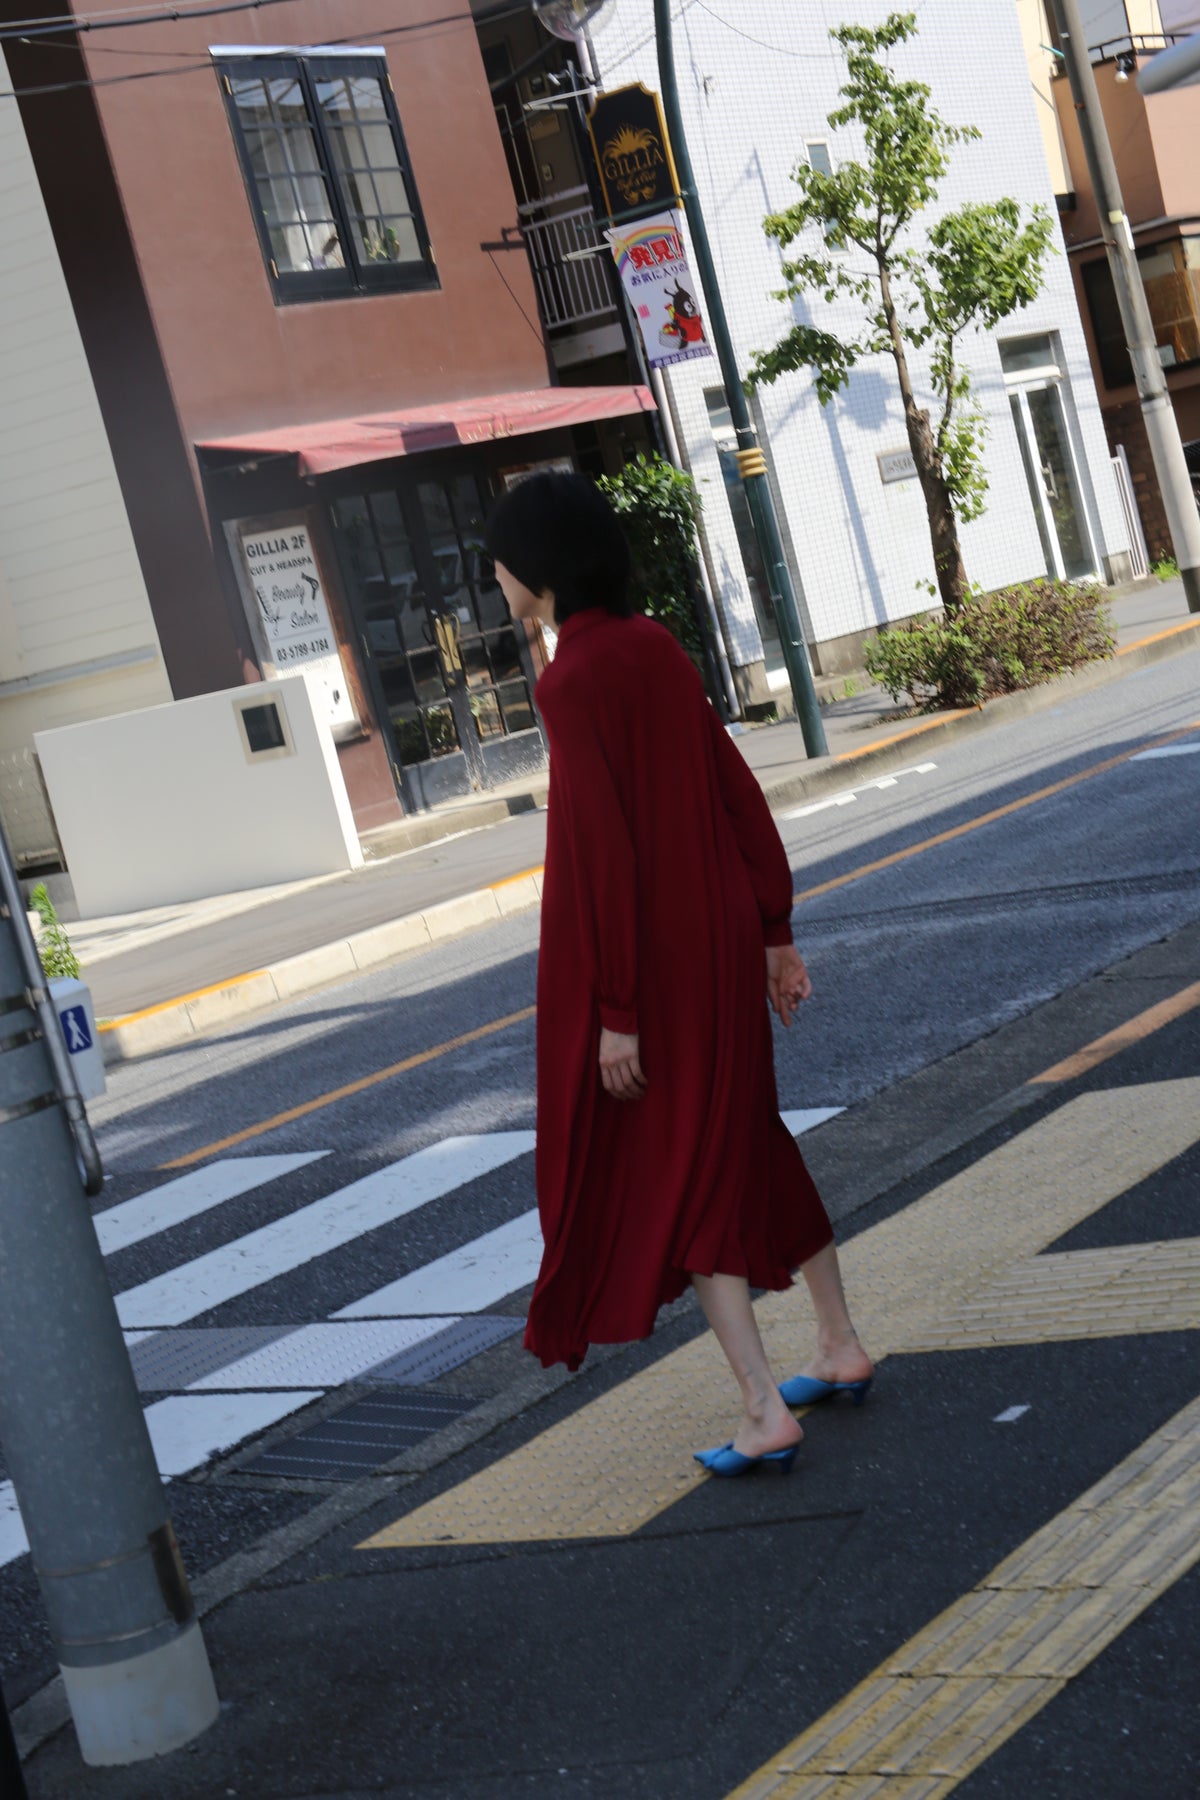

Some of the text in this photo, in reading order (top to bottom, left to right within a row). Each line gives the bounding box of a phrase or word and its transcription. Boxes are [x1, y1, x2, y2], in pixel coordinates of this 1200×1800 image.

[603, 147, 664, 180] GILLIA
[246, 534, 306, 558] GILLIA 2F
[250, 565, 267, 576] CUT
[275, 556, 313, 571] HEADSPA
[272, 582, 305, 606] Beauty
[290, 609, 320, 629] Salon
